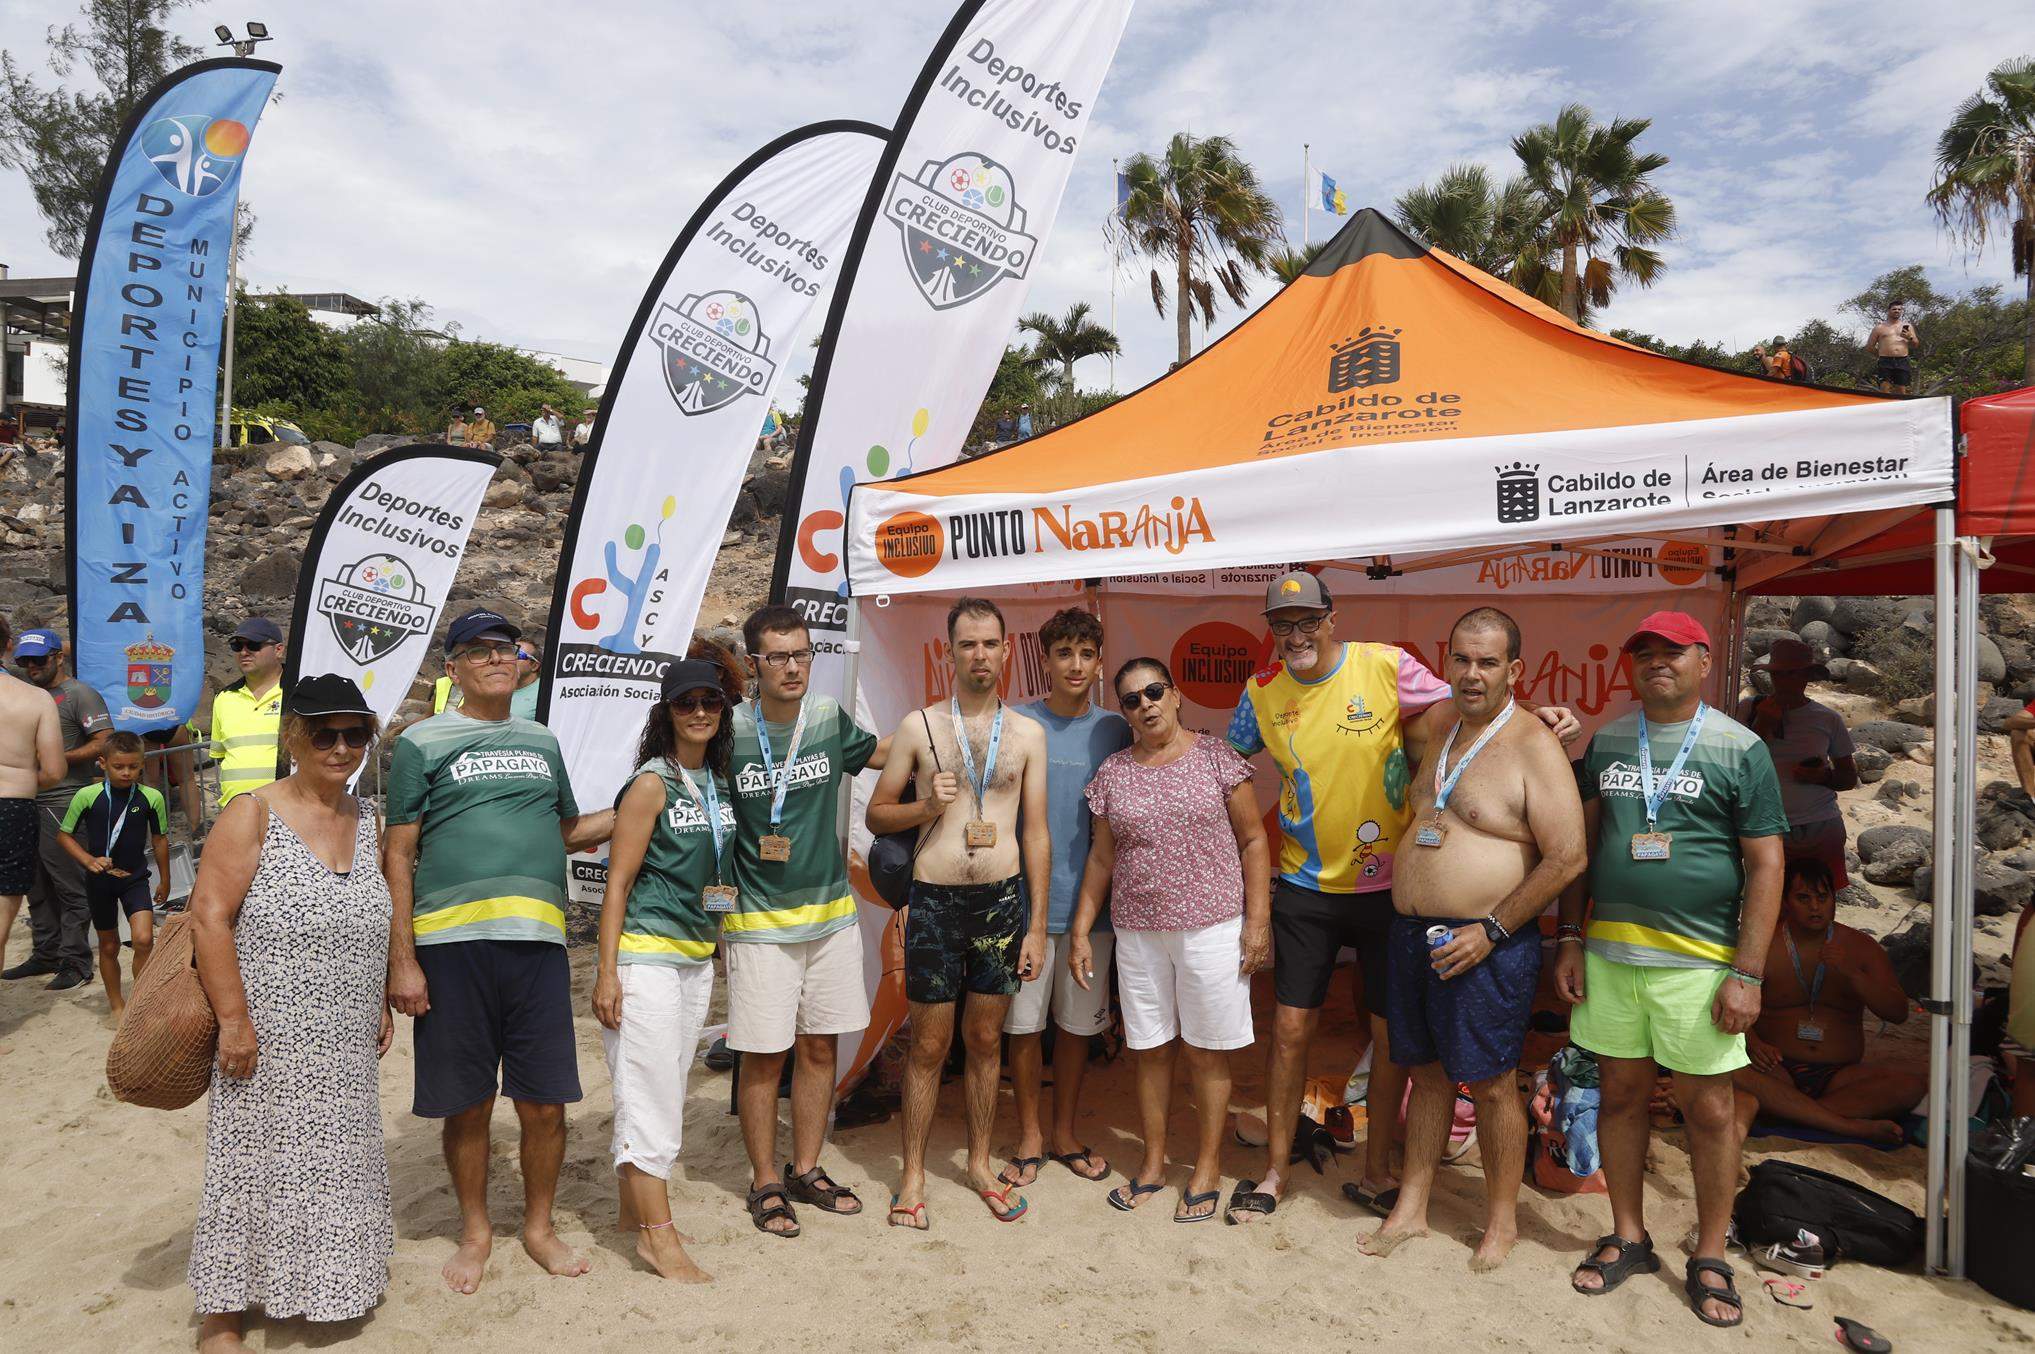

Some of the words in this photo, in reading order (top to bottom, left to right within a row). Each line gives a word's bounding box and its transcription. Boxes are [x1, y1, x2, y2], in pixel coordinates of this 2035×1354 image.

[967, 38, 1082, 120] Deportes
[940, 65, 1077, 155] Inclusivos
[731, 202, 829, 270] Deportes
[894, 197, 1025, 268] CRECIENDO
[922, 195, 949, 215] CLUB
[950, 210, 1007, 243] DEPORTIVO
[706, 221, 821, 297] Inclusivos
[174, 238, 208, 441] MUNICIPIO
[657, 323, 764, 387] CRECIENDO
[680, 322, 704, 340] CLUB
[704, 334, 752, 364] DEPORTIVO
[1263, 407, 1462, 442] Lanzarote
[1267, 393, 1402, 428] Cabildo
[1416, 391, 1461, 404] de
[1350, 419, 1458, 431] Bienestar
[1547, 471, 1636, 494] Cabildo
[1642, 469, 1672, 487] de
[1701, 462, 1753, 484] Área
[1761, 463, 1788, 480] de
[1796, 456, 1909, 478] Bienestar
[359, 481, 463, 530] Deportes
[1547, 492, 1672, 516] Lanzarote
[170, 470, 190, 599] ACTIVO
[338, 505, 460, 558] Inclusivos
[887, 523, 929, 537] Equipo
[950, 508, 1026, 560] PUNTO
[323, 594, 425, 628] CRECIENDO
[342, 589, 365, 600] CLUB
[365, 595, 412, 612] DEPORTIVO
[1190, 642, 1248, 658] Equipo
[623, 687, 661, 702] Socia
[455, 758, 548, 777] PAPAGAYO
[458, 773, 503, 785] DREAMS
